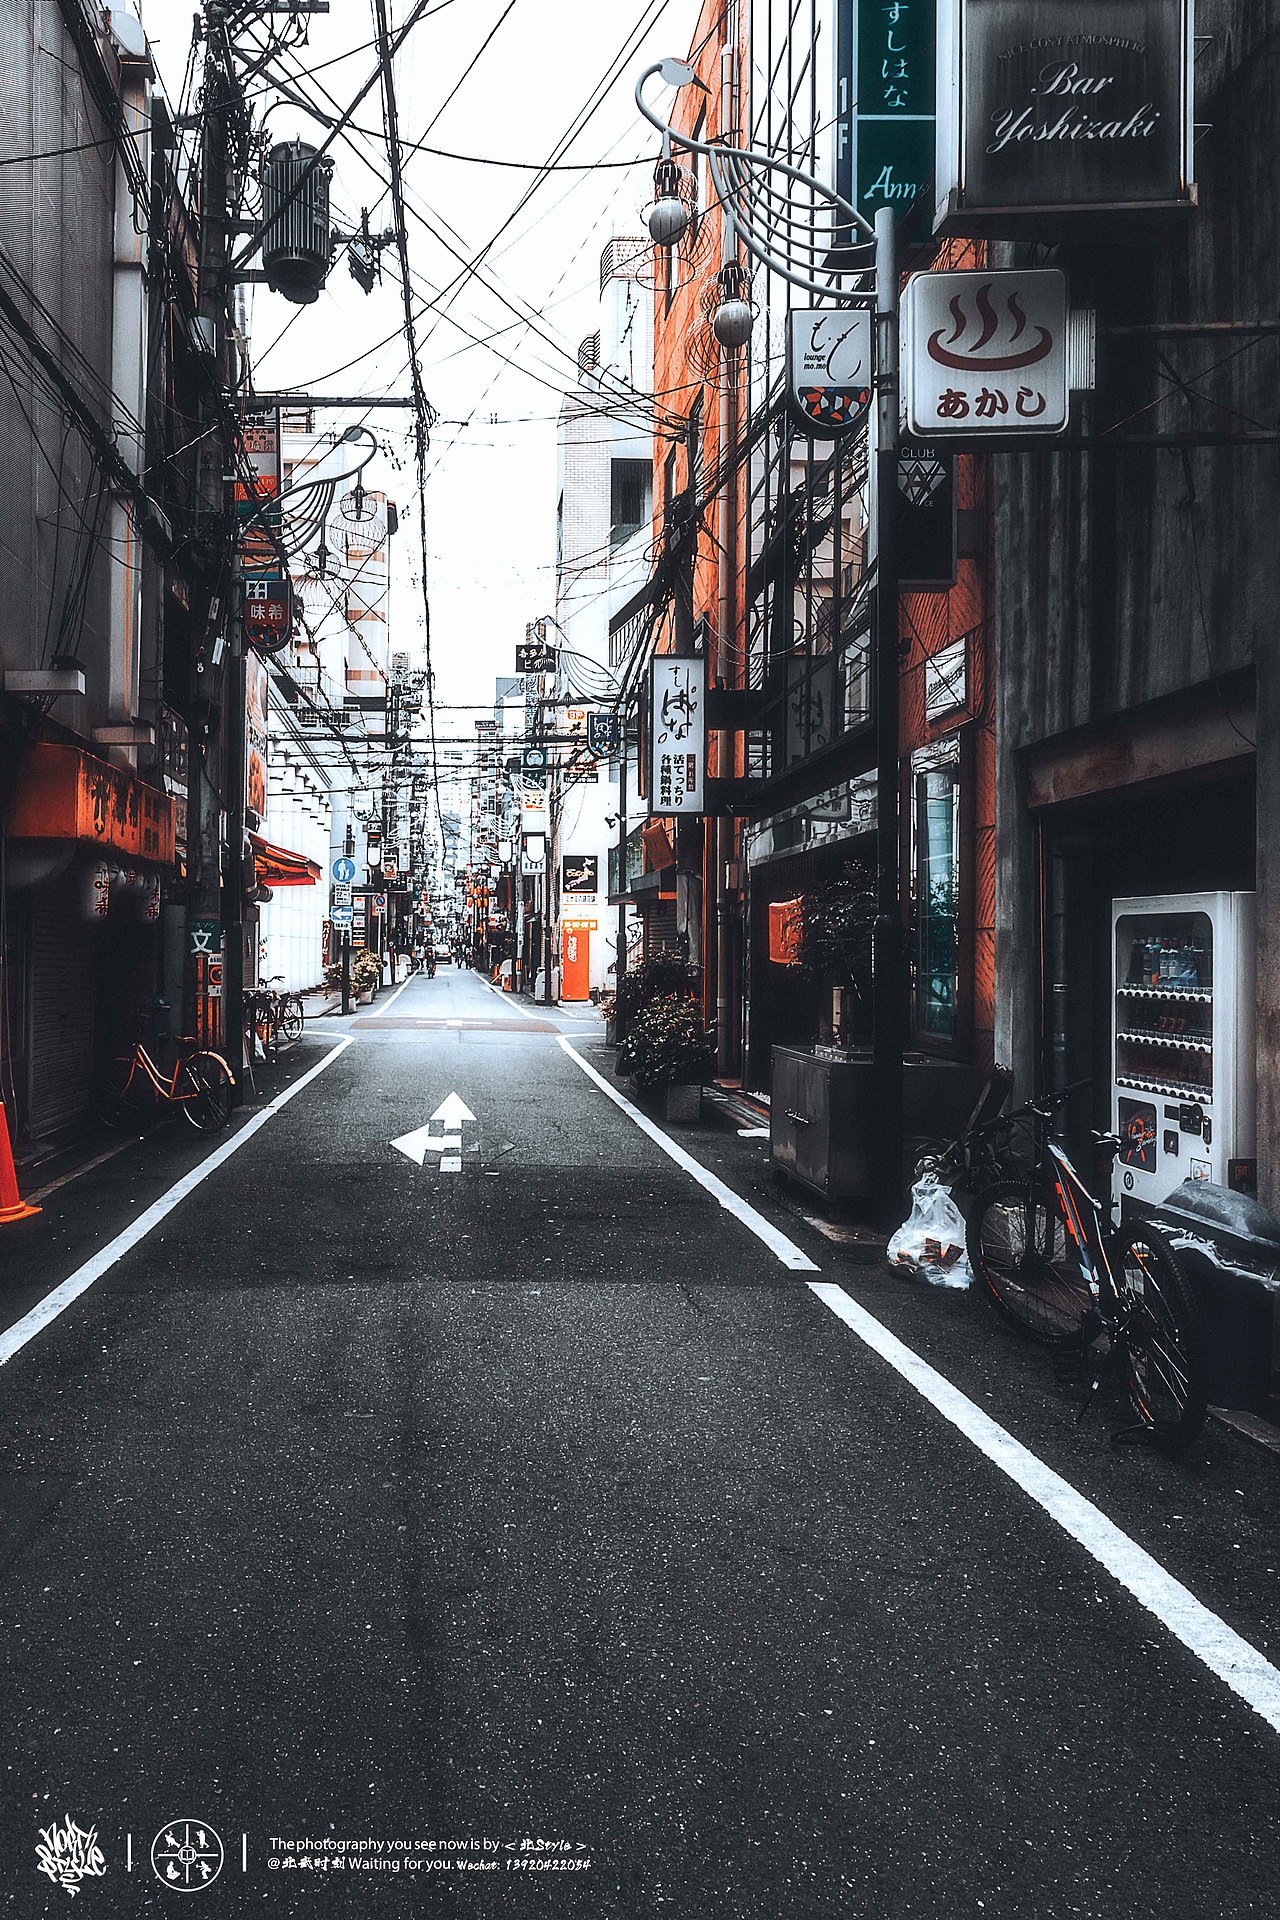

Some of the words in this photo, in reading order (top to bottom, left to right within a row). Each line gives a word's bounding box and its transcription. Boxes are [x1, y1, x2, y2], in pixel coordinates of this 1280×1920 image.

[880, 1, 910, 107] すしはな
[1030, 36, 1062, 50] COSY
[1030, 60, 1114, 95] Bar
[986, 103, 1161, 153] Yoshizaki
[863, 165, 929, 199] Ann
[803, 353, 827, 362] lounge
[936, 386, 1047, 419] あかし
[901, 447, 936, 459] CLUB
[250, 604, 283, 620] 味希
[668, 665, 682, 688] すし
[659, 754, 672, 807] 各種鍋料理
[673, 754, 685, 807] 活てっちり
[190, 928, 213, 954] 文
